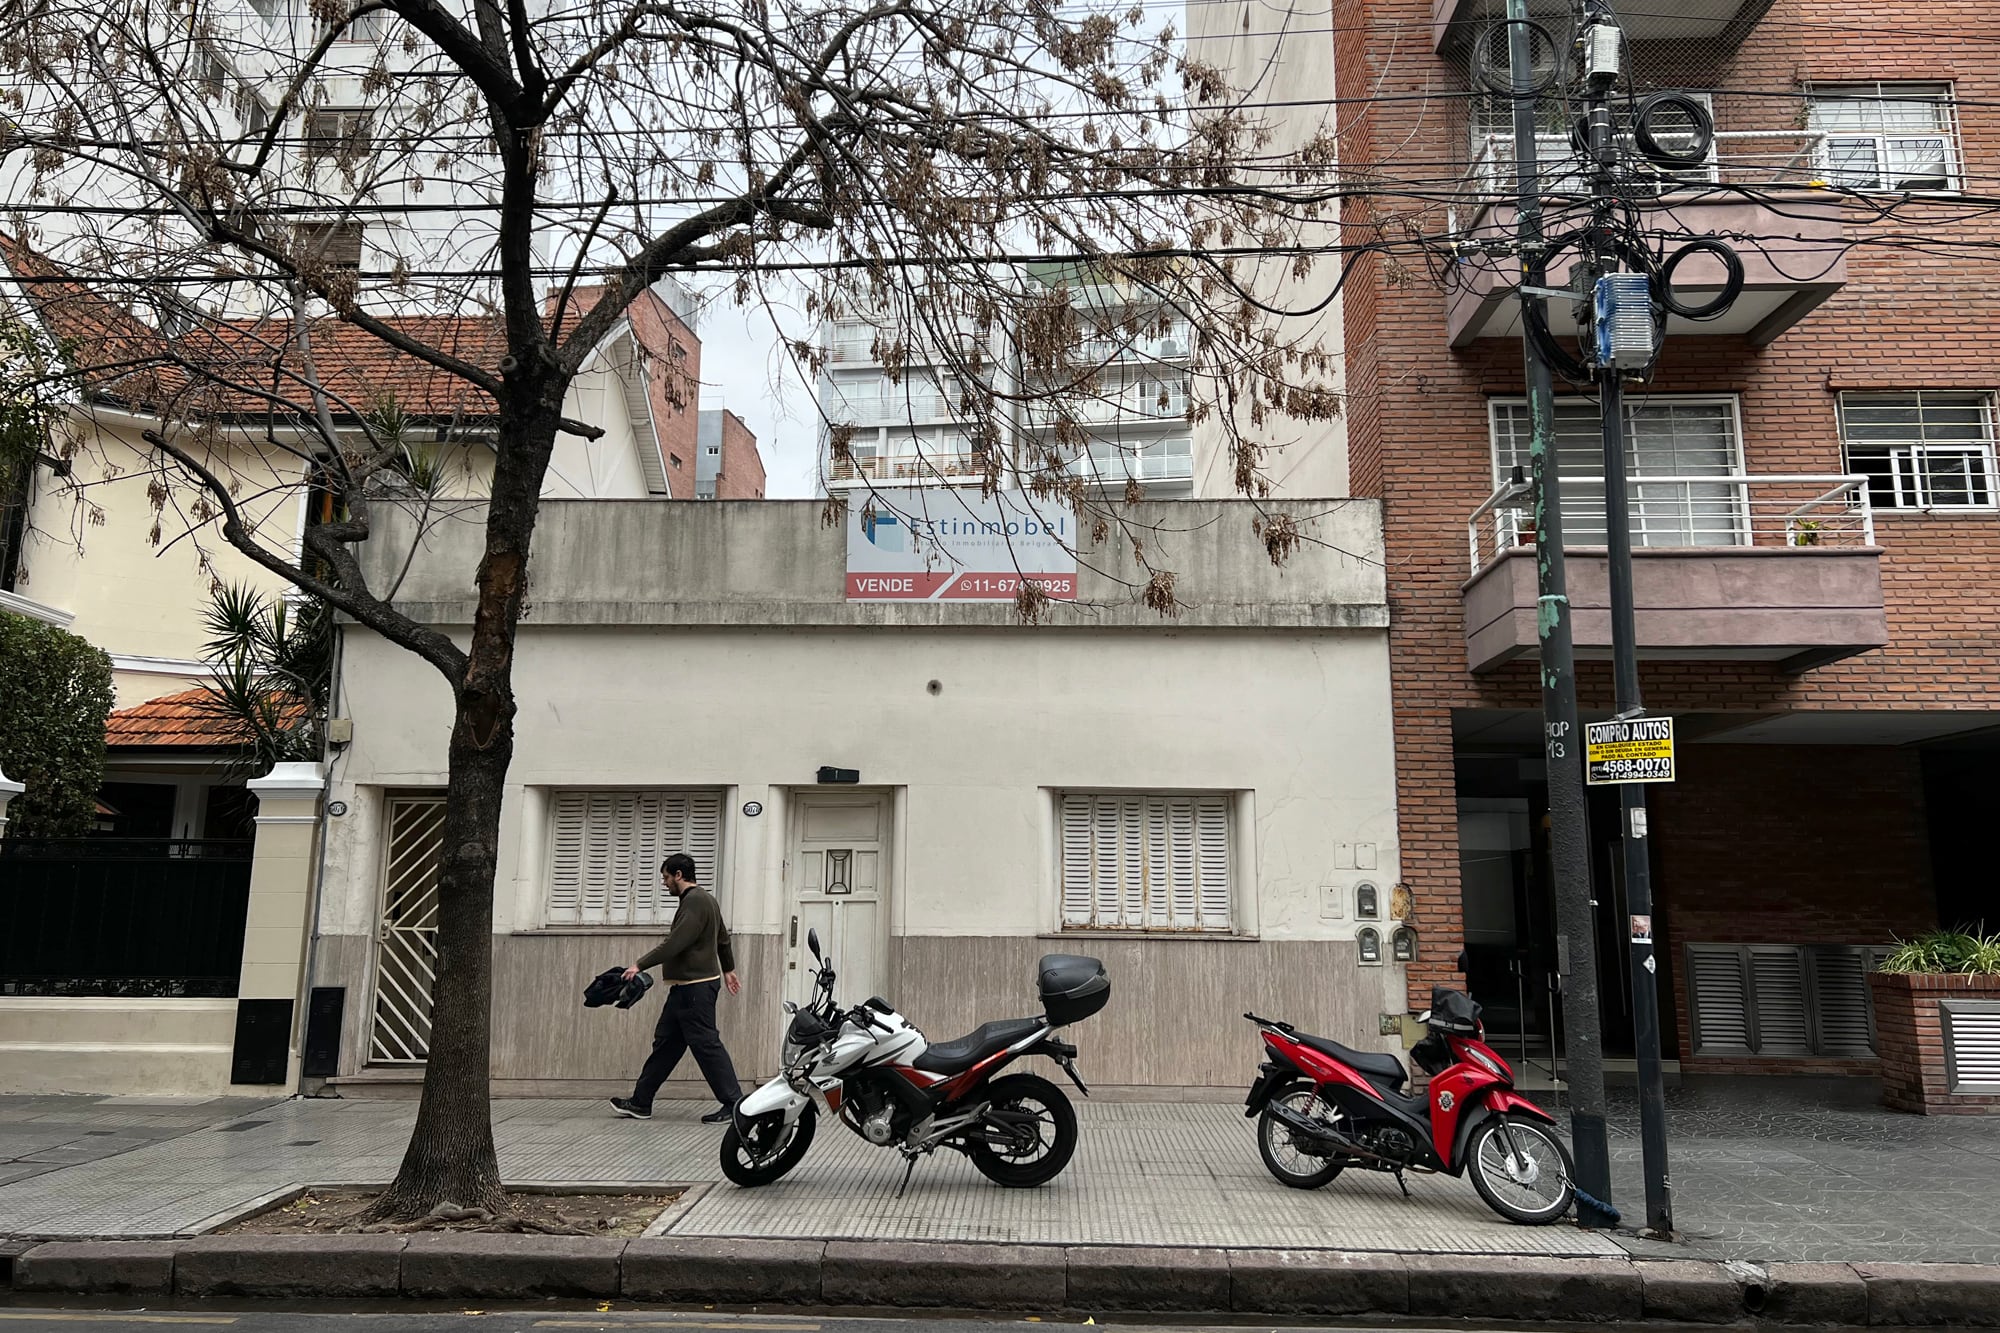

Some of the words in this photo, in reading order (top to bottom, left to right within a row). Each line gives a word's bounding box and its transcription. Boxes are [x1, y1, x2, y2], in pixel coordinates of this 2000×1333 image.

[910, 516, 1064, 536] Estinmobel
[952, 540, 1015, 548] Inmobiliaro
[1020, 540, 1063, 548] Belgran
[856, 578, 914, 593] VENDE
[974, 578, 1071, 593] 11-6749925
[1589, 723, 1630, 744] COMPRO
[1632, 721, 1669, 741] AUTOS
[1602, 757, 1670, 773] 4568-0070
[1609, 770, 1670, 780] 11-4994-0349
